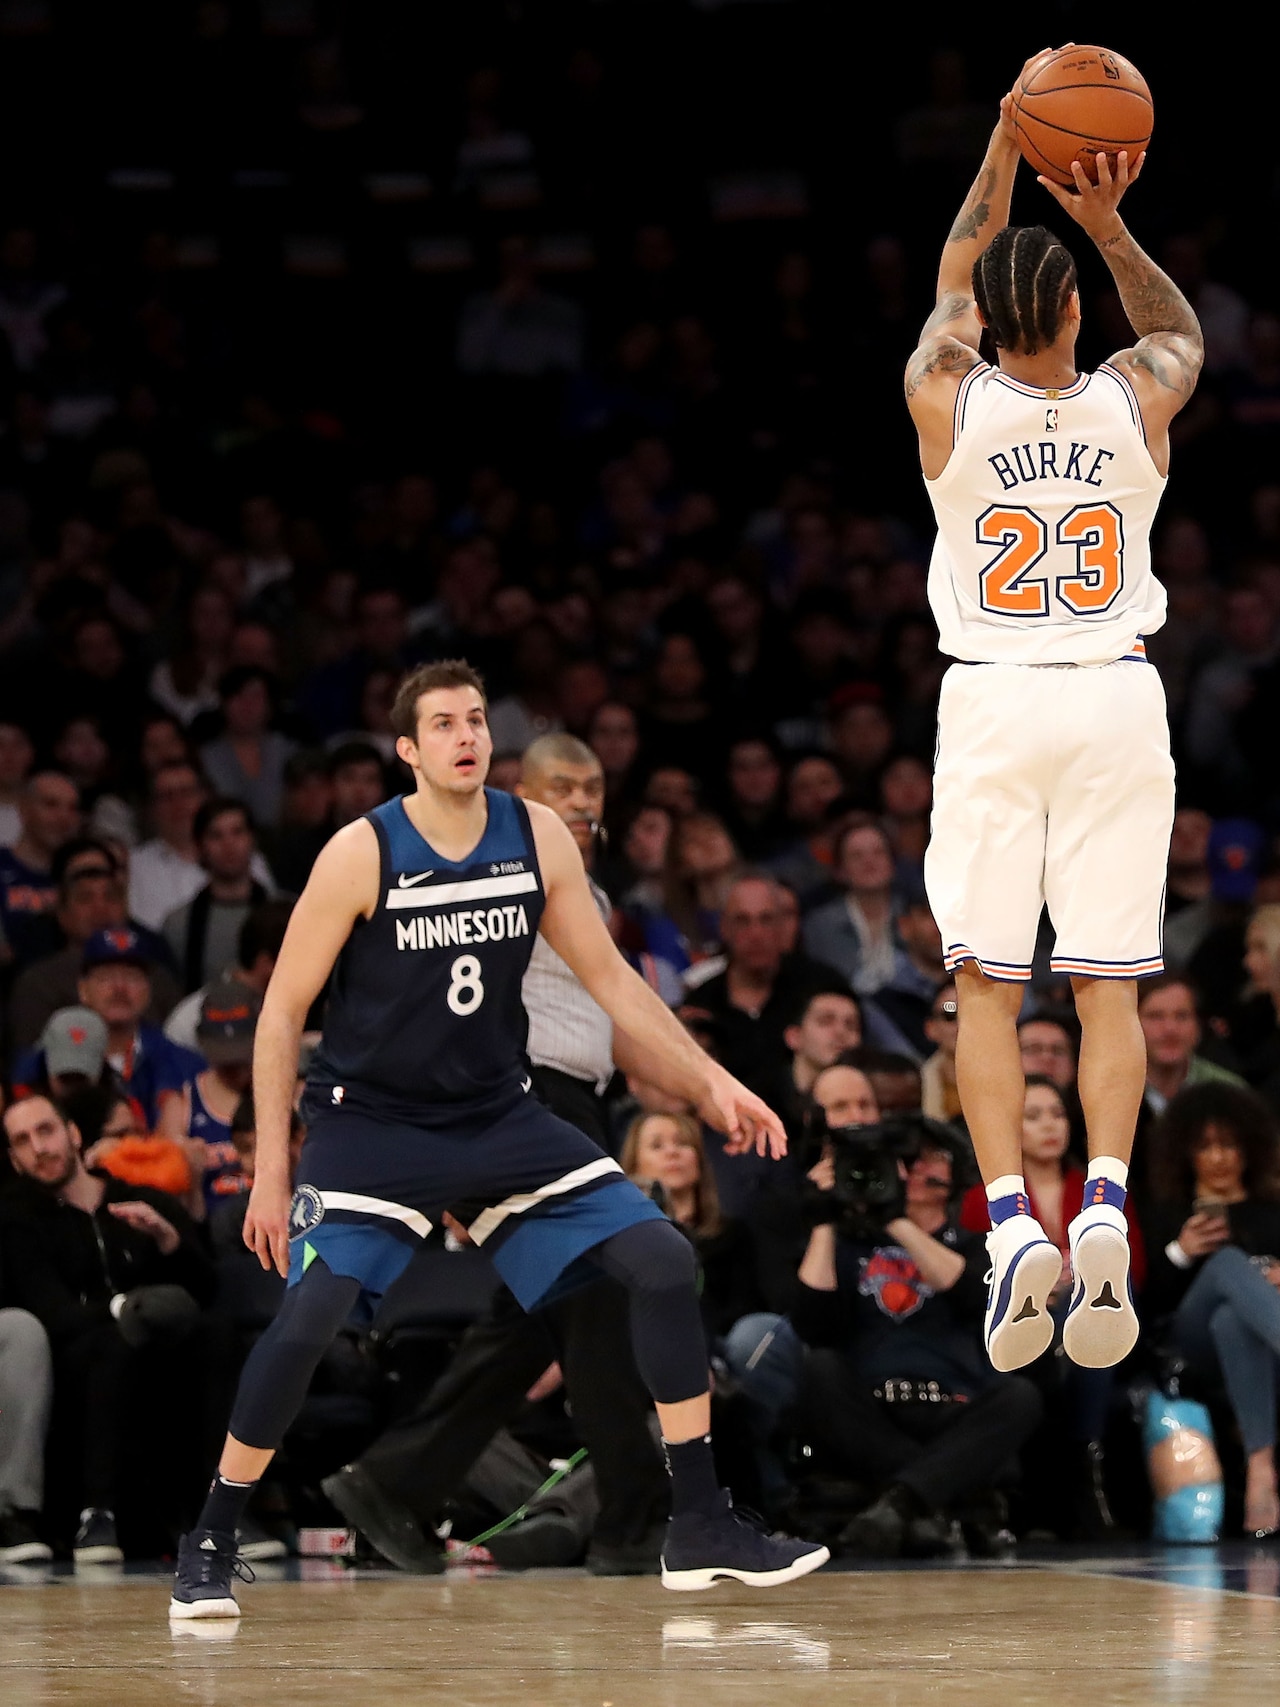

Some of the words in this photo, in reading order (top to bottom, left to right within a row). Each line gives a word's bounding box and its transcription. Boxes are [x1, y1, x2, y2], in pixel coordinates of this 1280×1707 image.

[988, 441, 1115, 491] BURKE
[976, 501, 1124, 617] 23
[501, 861, 525, 875] fitbit
[395, 904, 529, 951] MINNESOTA
[446, 954, 485, 1017] 8
